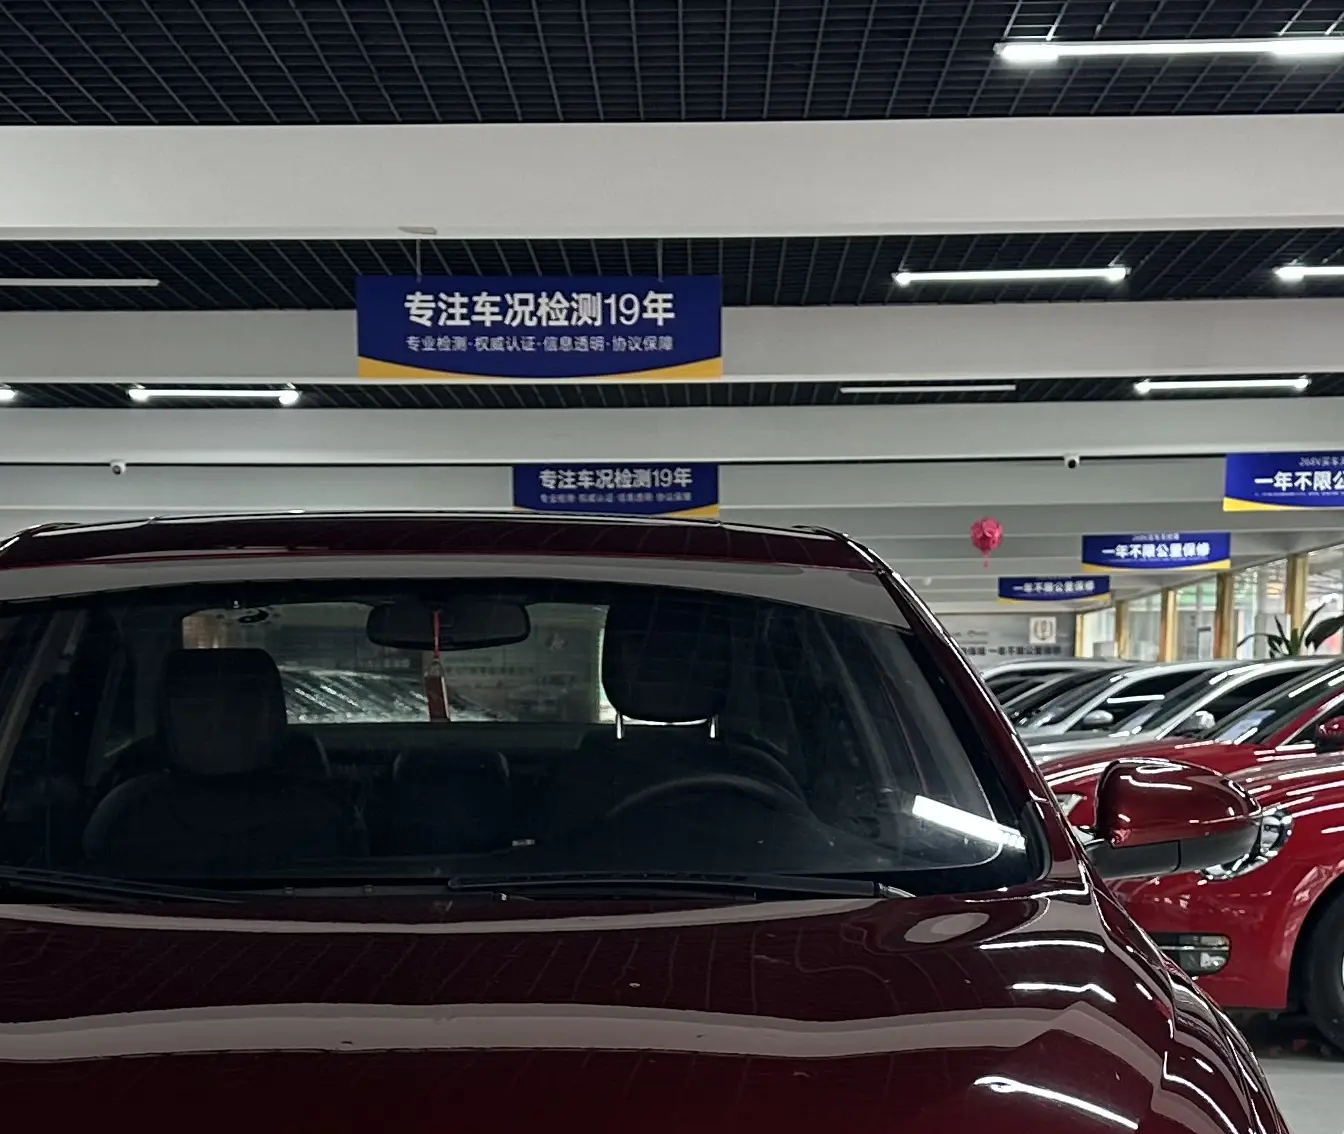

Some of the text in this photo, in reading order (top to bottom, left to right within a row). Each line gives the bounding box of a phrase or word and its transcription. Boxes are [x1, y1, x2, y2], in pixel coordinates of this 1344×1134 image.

[404, 291, 676, 327] 专注车况检测19年
[539, 468, 693, 489] 专注车况检测19年
